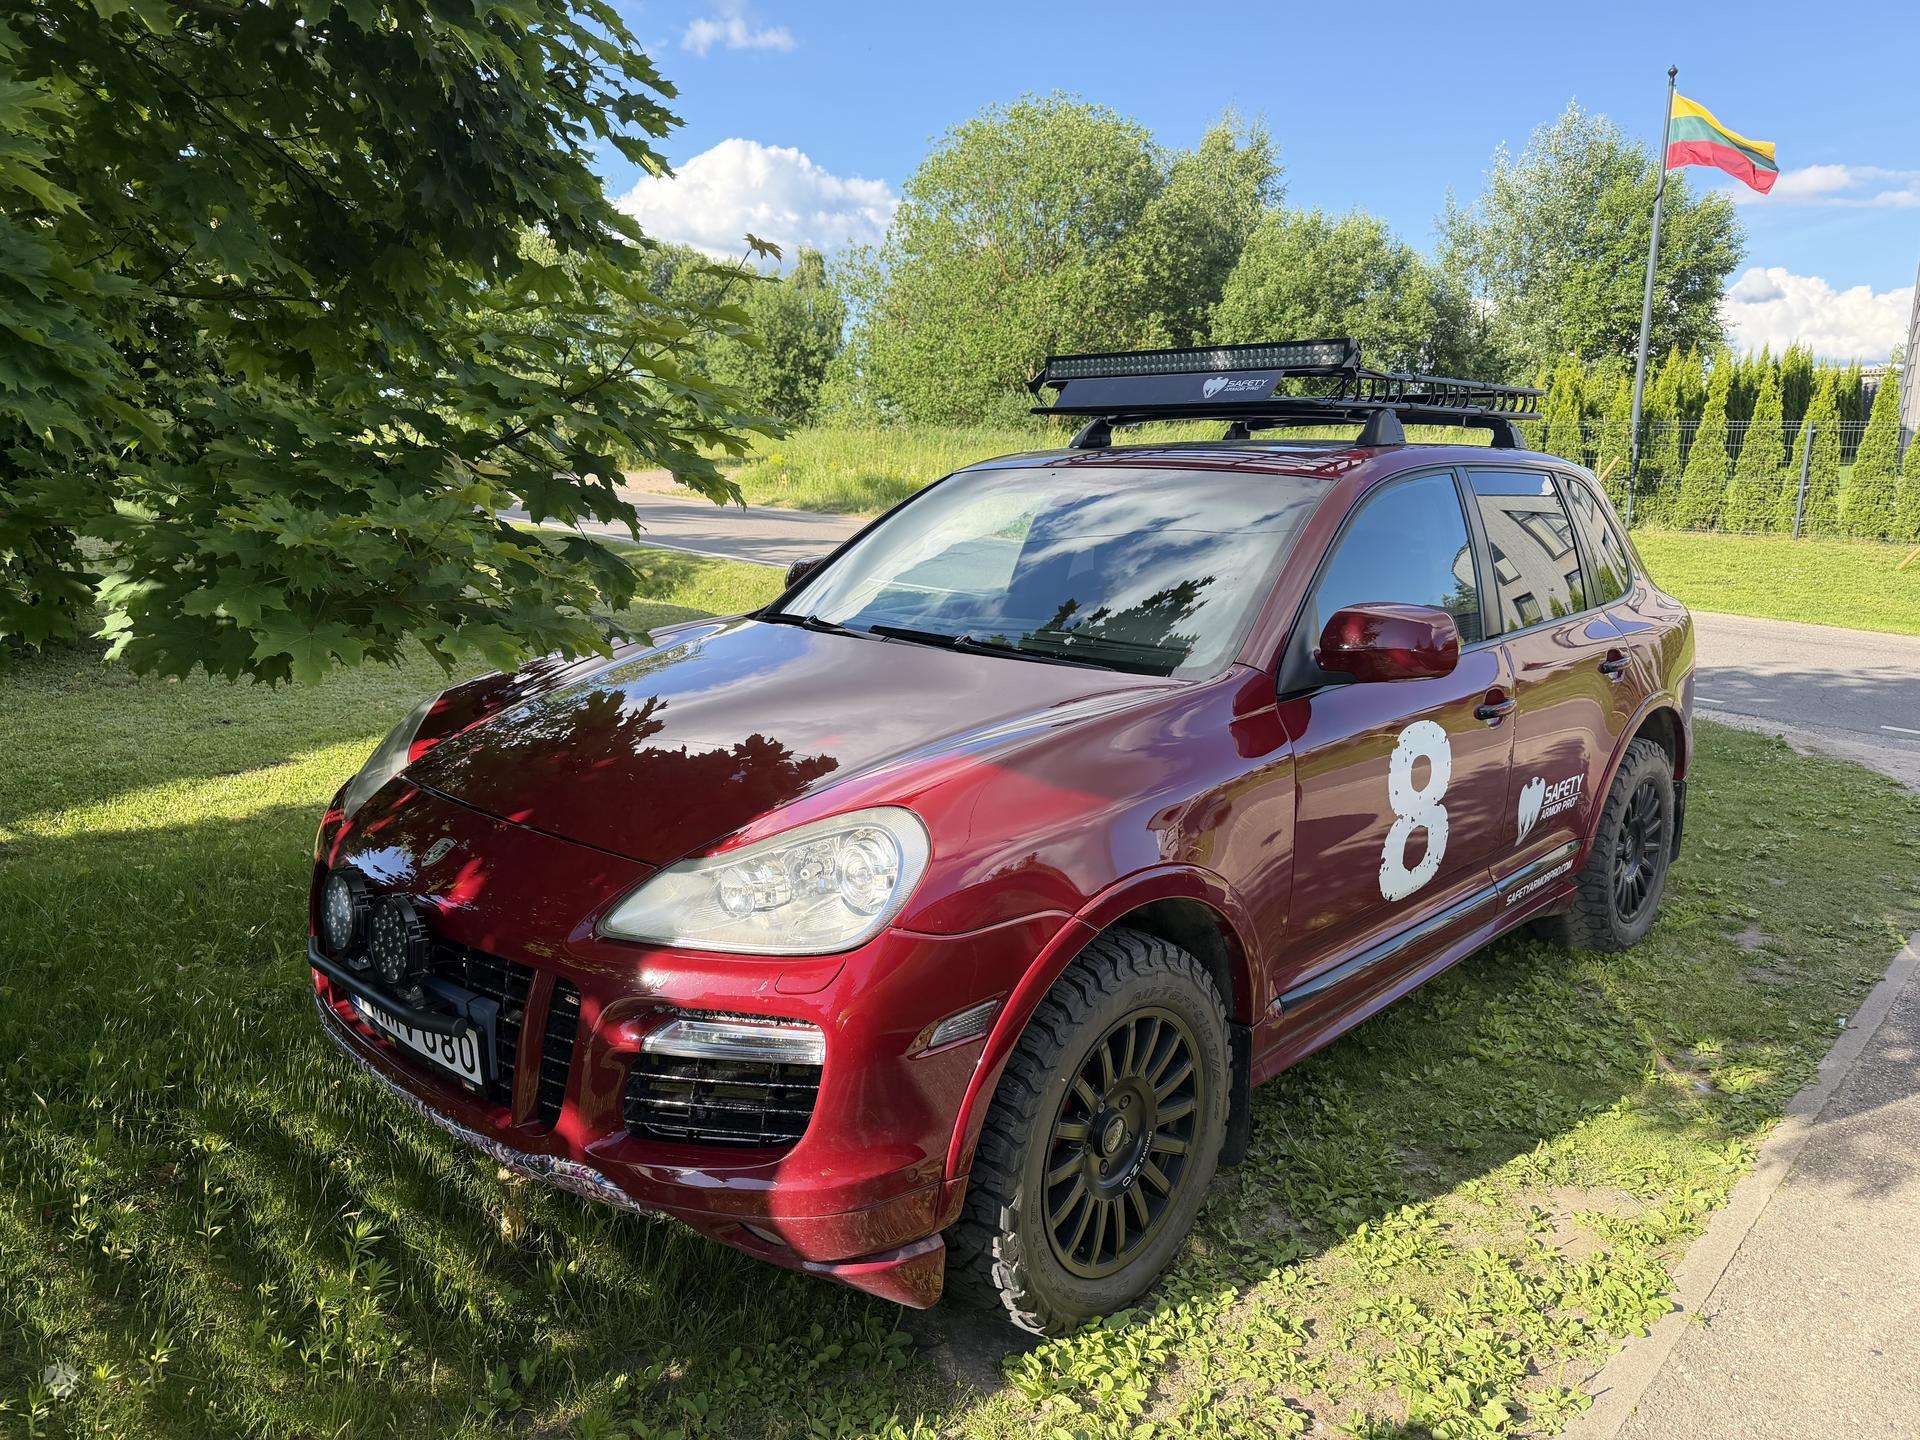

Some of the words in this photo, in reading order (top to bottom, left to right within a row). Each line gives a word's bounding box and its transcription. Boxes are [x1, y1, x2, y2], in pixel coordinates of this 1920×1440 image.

[1228, 379, 1269, 388] SAFETY
[1544, 773, 1584, 805] SAFETY
[1379, 720, 1452, 902] 8
[1540, 802, 1562, 821] ARMOR
[1505, 859, 1573, 907] SAFETYARMORPRO.COM
